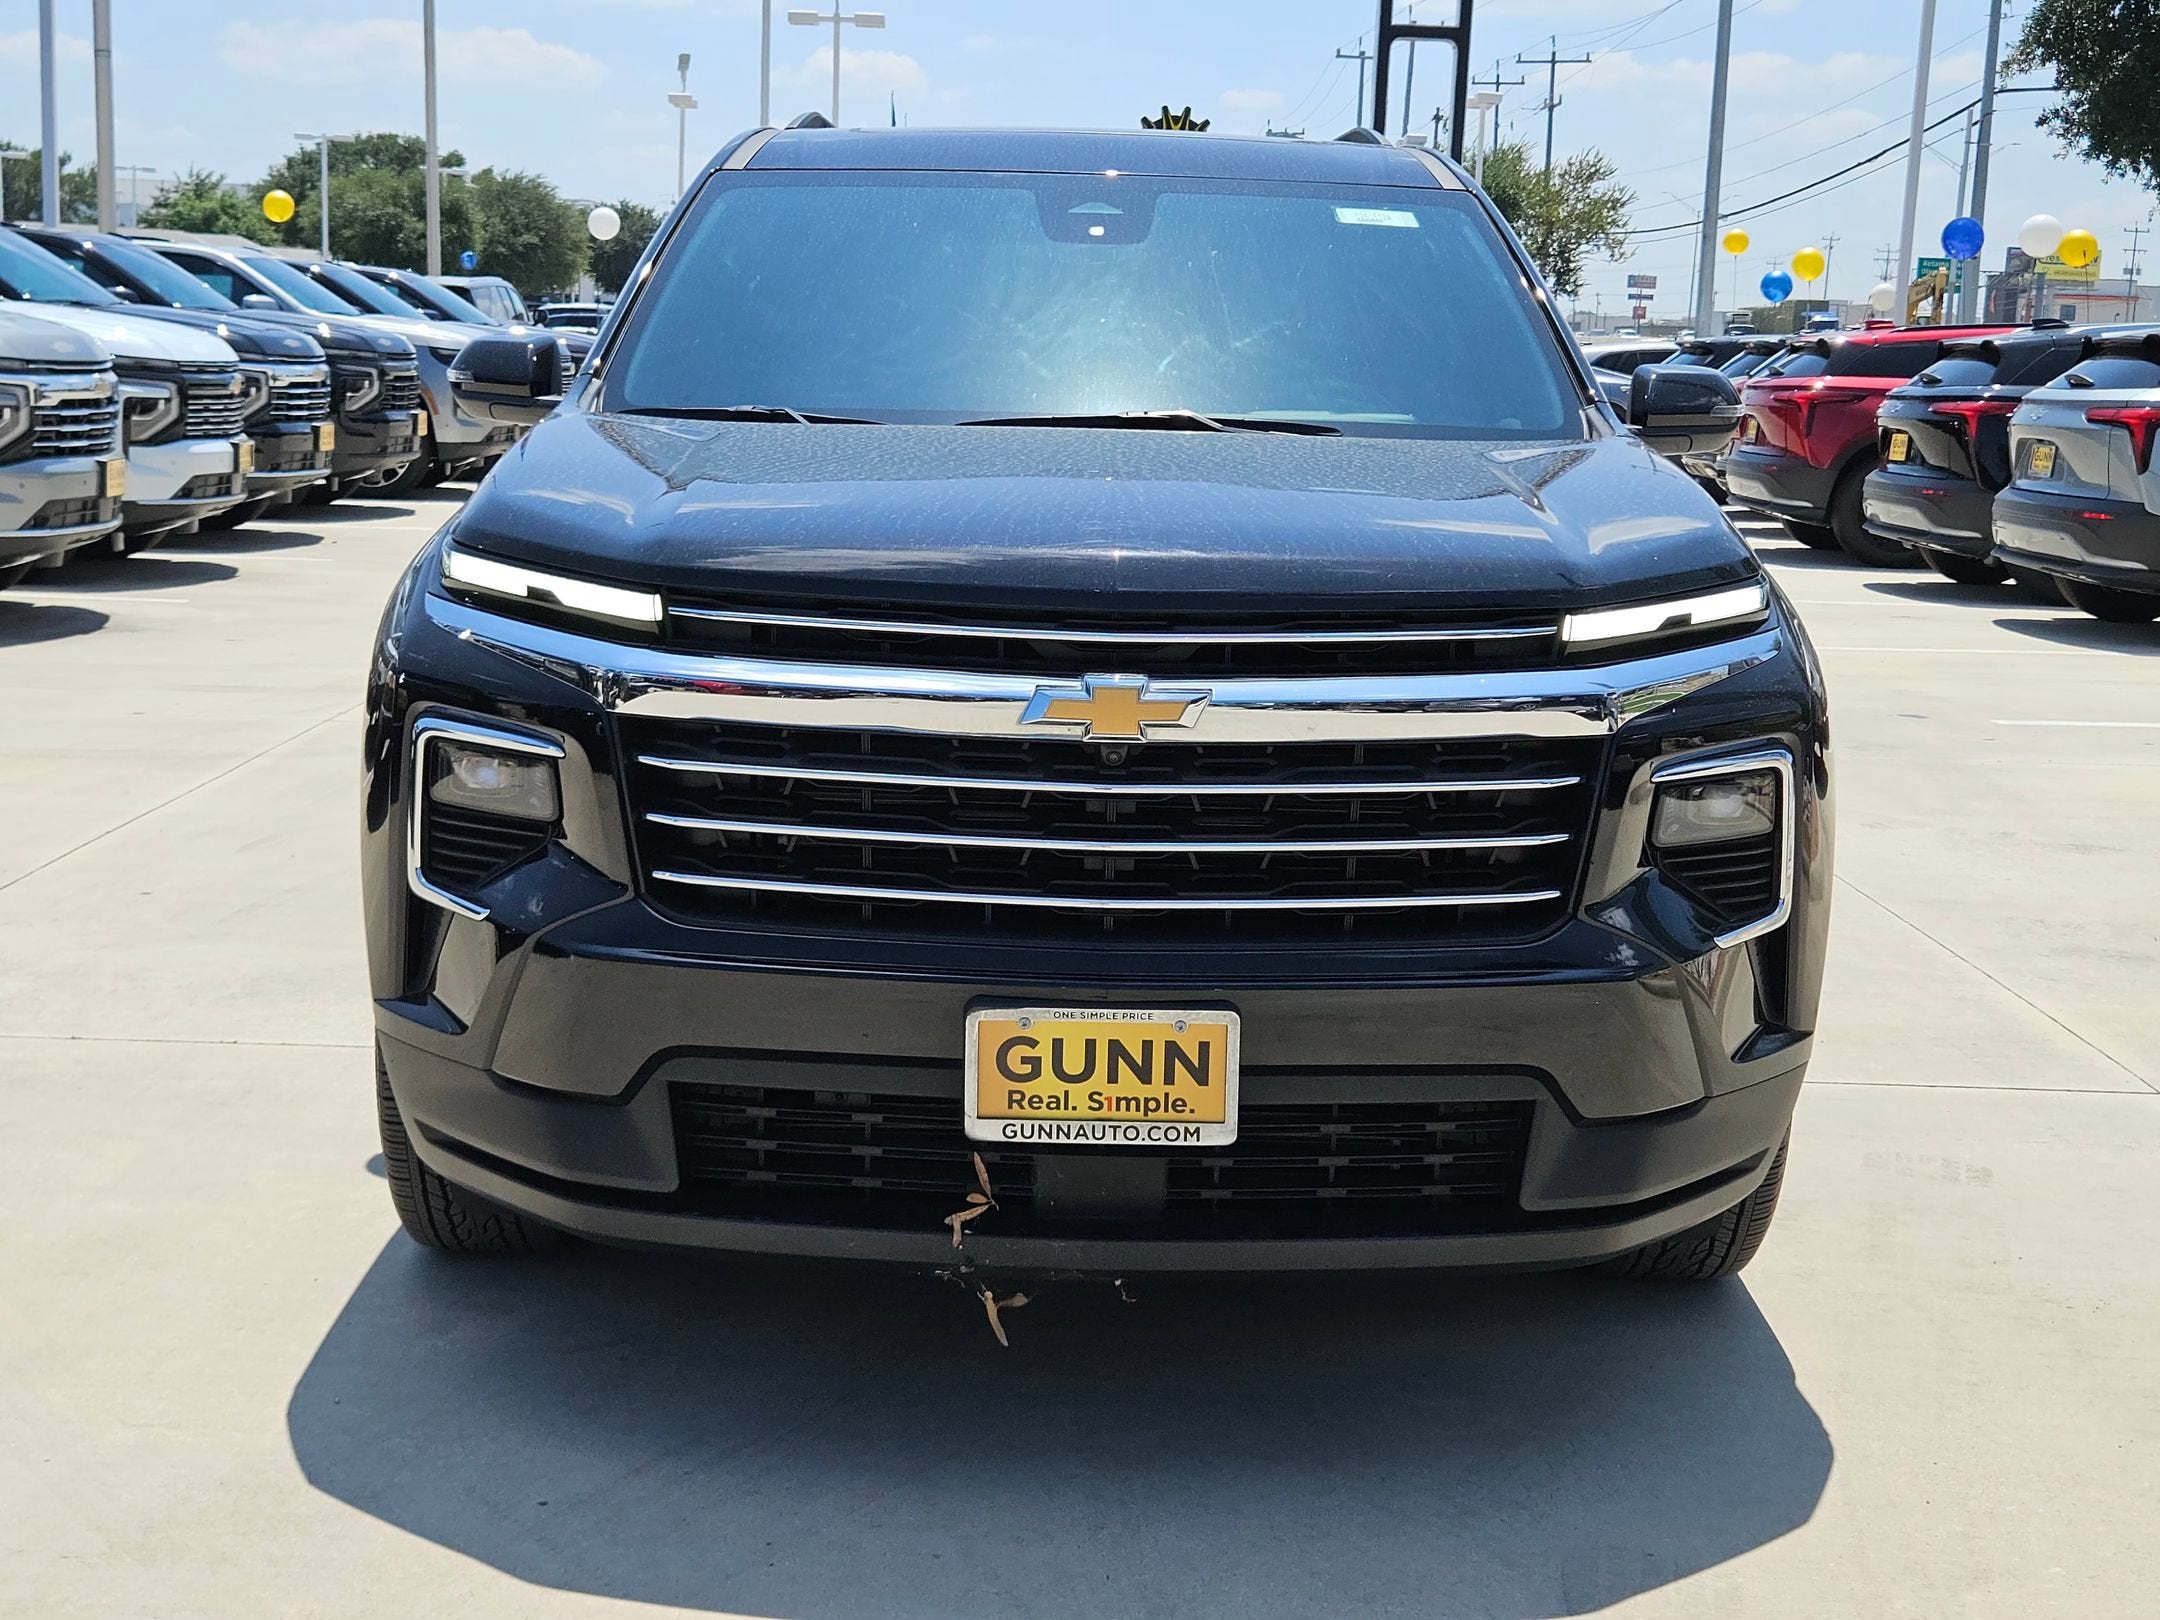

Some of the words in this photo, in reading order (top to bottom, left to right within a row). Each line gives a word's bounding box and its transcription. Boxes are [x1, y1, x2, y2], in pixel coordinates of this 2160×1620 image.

[1053, 1011, 1077, 1020] ONE
[1079, 1012, 1119, 1021] SIMPLE
[1122, 1012, 1154, 1021] PRICE
[995, 1035, 1211, 1087] GUNN
[1007, 1089, 1078, 1112] Real.
[1087, 1090, 1196, 1117] S1mple.
[1001, 1122, 1201, 1143] GUNNAUTO.COM
